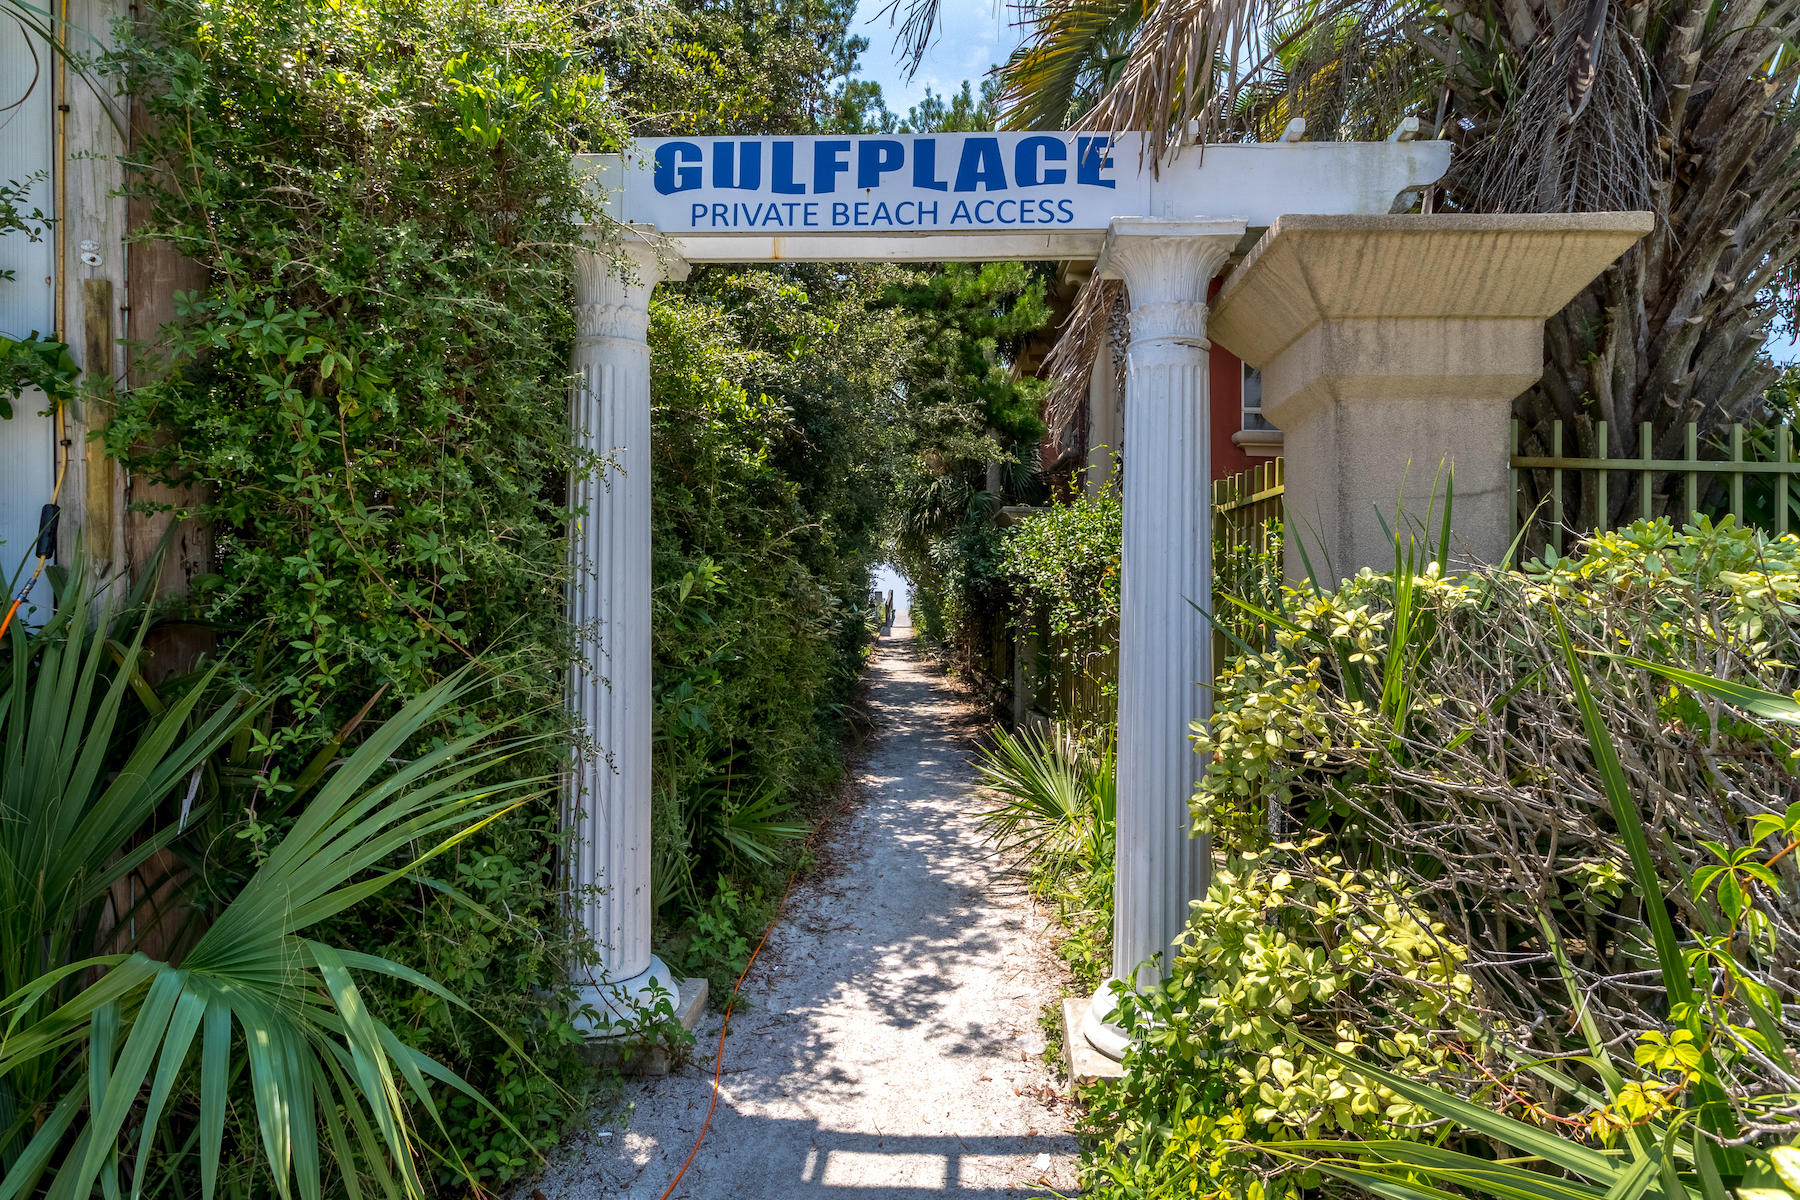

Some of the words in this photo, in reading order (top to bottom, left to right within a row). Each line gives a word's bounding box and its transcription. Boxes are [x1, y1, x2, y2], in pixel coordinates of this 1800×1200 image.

[653, 136, 1116, 196] GULFPLACE
[691, 203, 818, 227] PRIVATE
[831, 200, 938, 226] BEACH
[949, 199, 1074, 225] ACCESS
